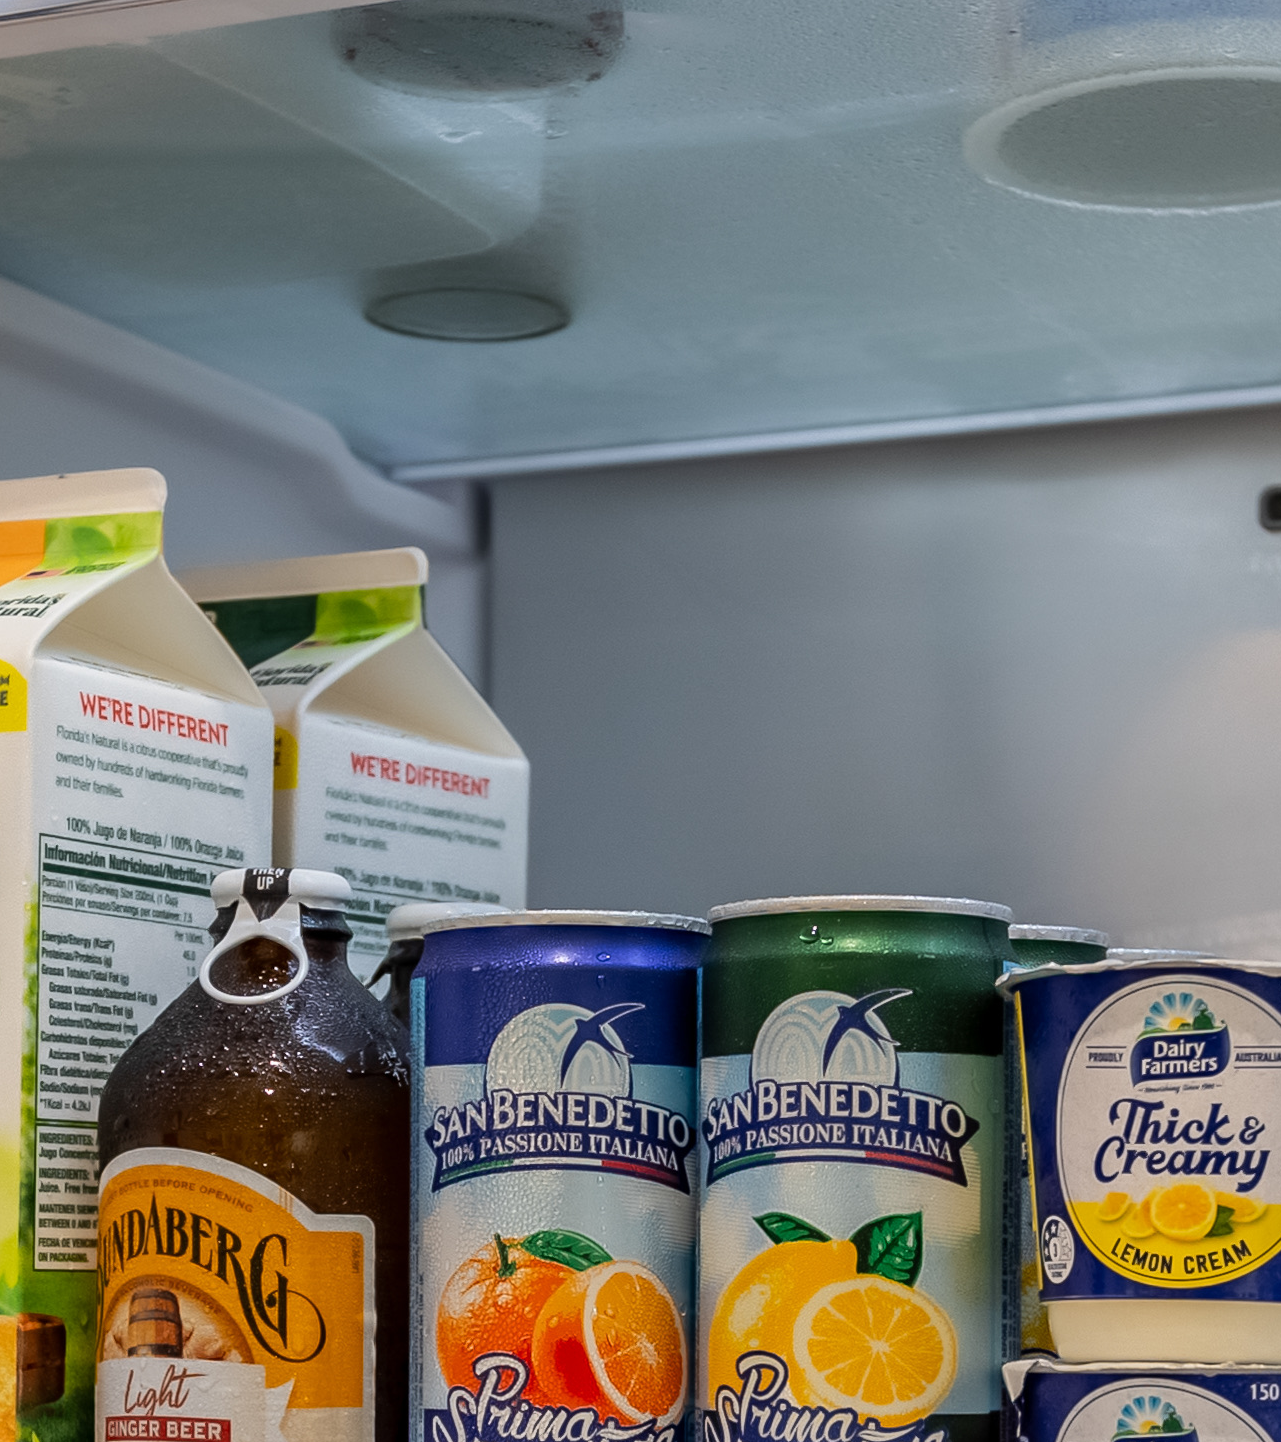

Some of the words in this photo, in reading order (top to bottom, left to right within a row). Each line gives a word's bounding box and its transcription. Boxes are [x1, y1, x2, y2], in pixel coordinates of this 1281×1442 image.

[79, 690, 135, 727] WE'RE
[138, 705, 229, 747] DIFFERENT
[145, 766, 192, 790] hardworking
[350, 752, 401, 785] WE'RE
[404, 764, 491, 800] DIFFERENT
[44, 843, 106, 869] Información
[66, 817, 91, 835] 100%
[93, 822, 114, 841] Jugo
[129, 828, 163, 849] Naranja
[170, 835, 193, 853] 100%
[194, 839, 223, 860] Orange
[256, 875, 275, 891] UP
[1088, 1052, 1124, 1063] PROUDLY
[1141, 1057, 1218, 1076] Farmers
[1154, 1038, 1206, 1059] Dairy
[1108, 1097, 1235, 1146] Thick
[1237, 1115, 1266, 1146] &
[440, 1144, 475, 1171] 100%
[479, 1132, 583, 1159] PASSIONE
[587, 1133, 679, 1172] ITALIANA
[713, 1135, 742, 1164] 100%
[745, 1123, 846, 1152] PASSIONE
[851, 1123, 954, 1163] ITALIANA
[1093, 1134, 1271, 1193] Creamy
[152, 1178, 196, 1192] BEFORE
[199, 1184, 255, 1214] OPENING
[1110, 1237, 1174, 1275] LEMON
[1183, 1239, 1253, 1275] CREAM
[103, 1192, 325, 1360] UNDABERG
[123, 1364, 208, 1416] Light
[1249, 1382, 1280, 1401] 150
[107, 1419, 161, 1438] GINGER
[166, 1420, 222, 1441] BEER
